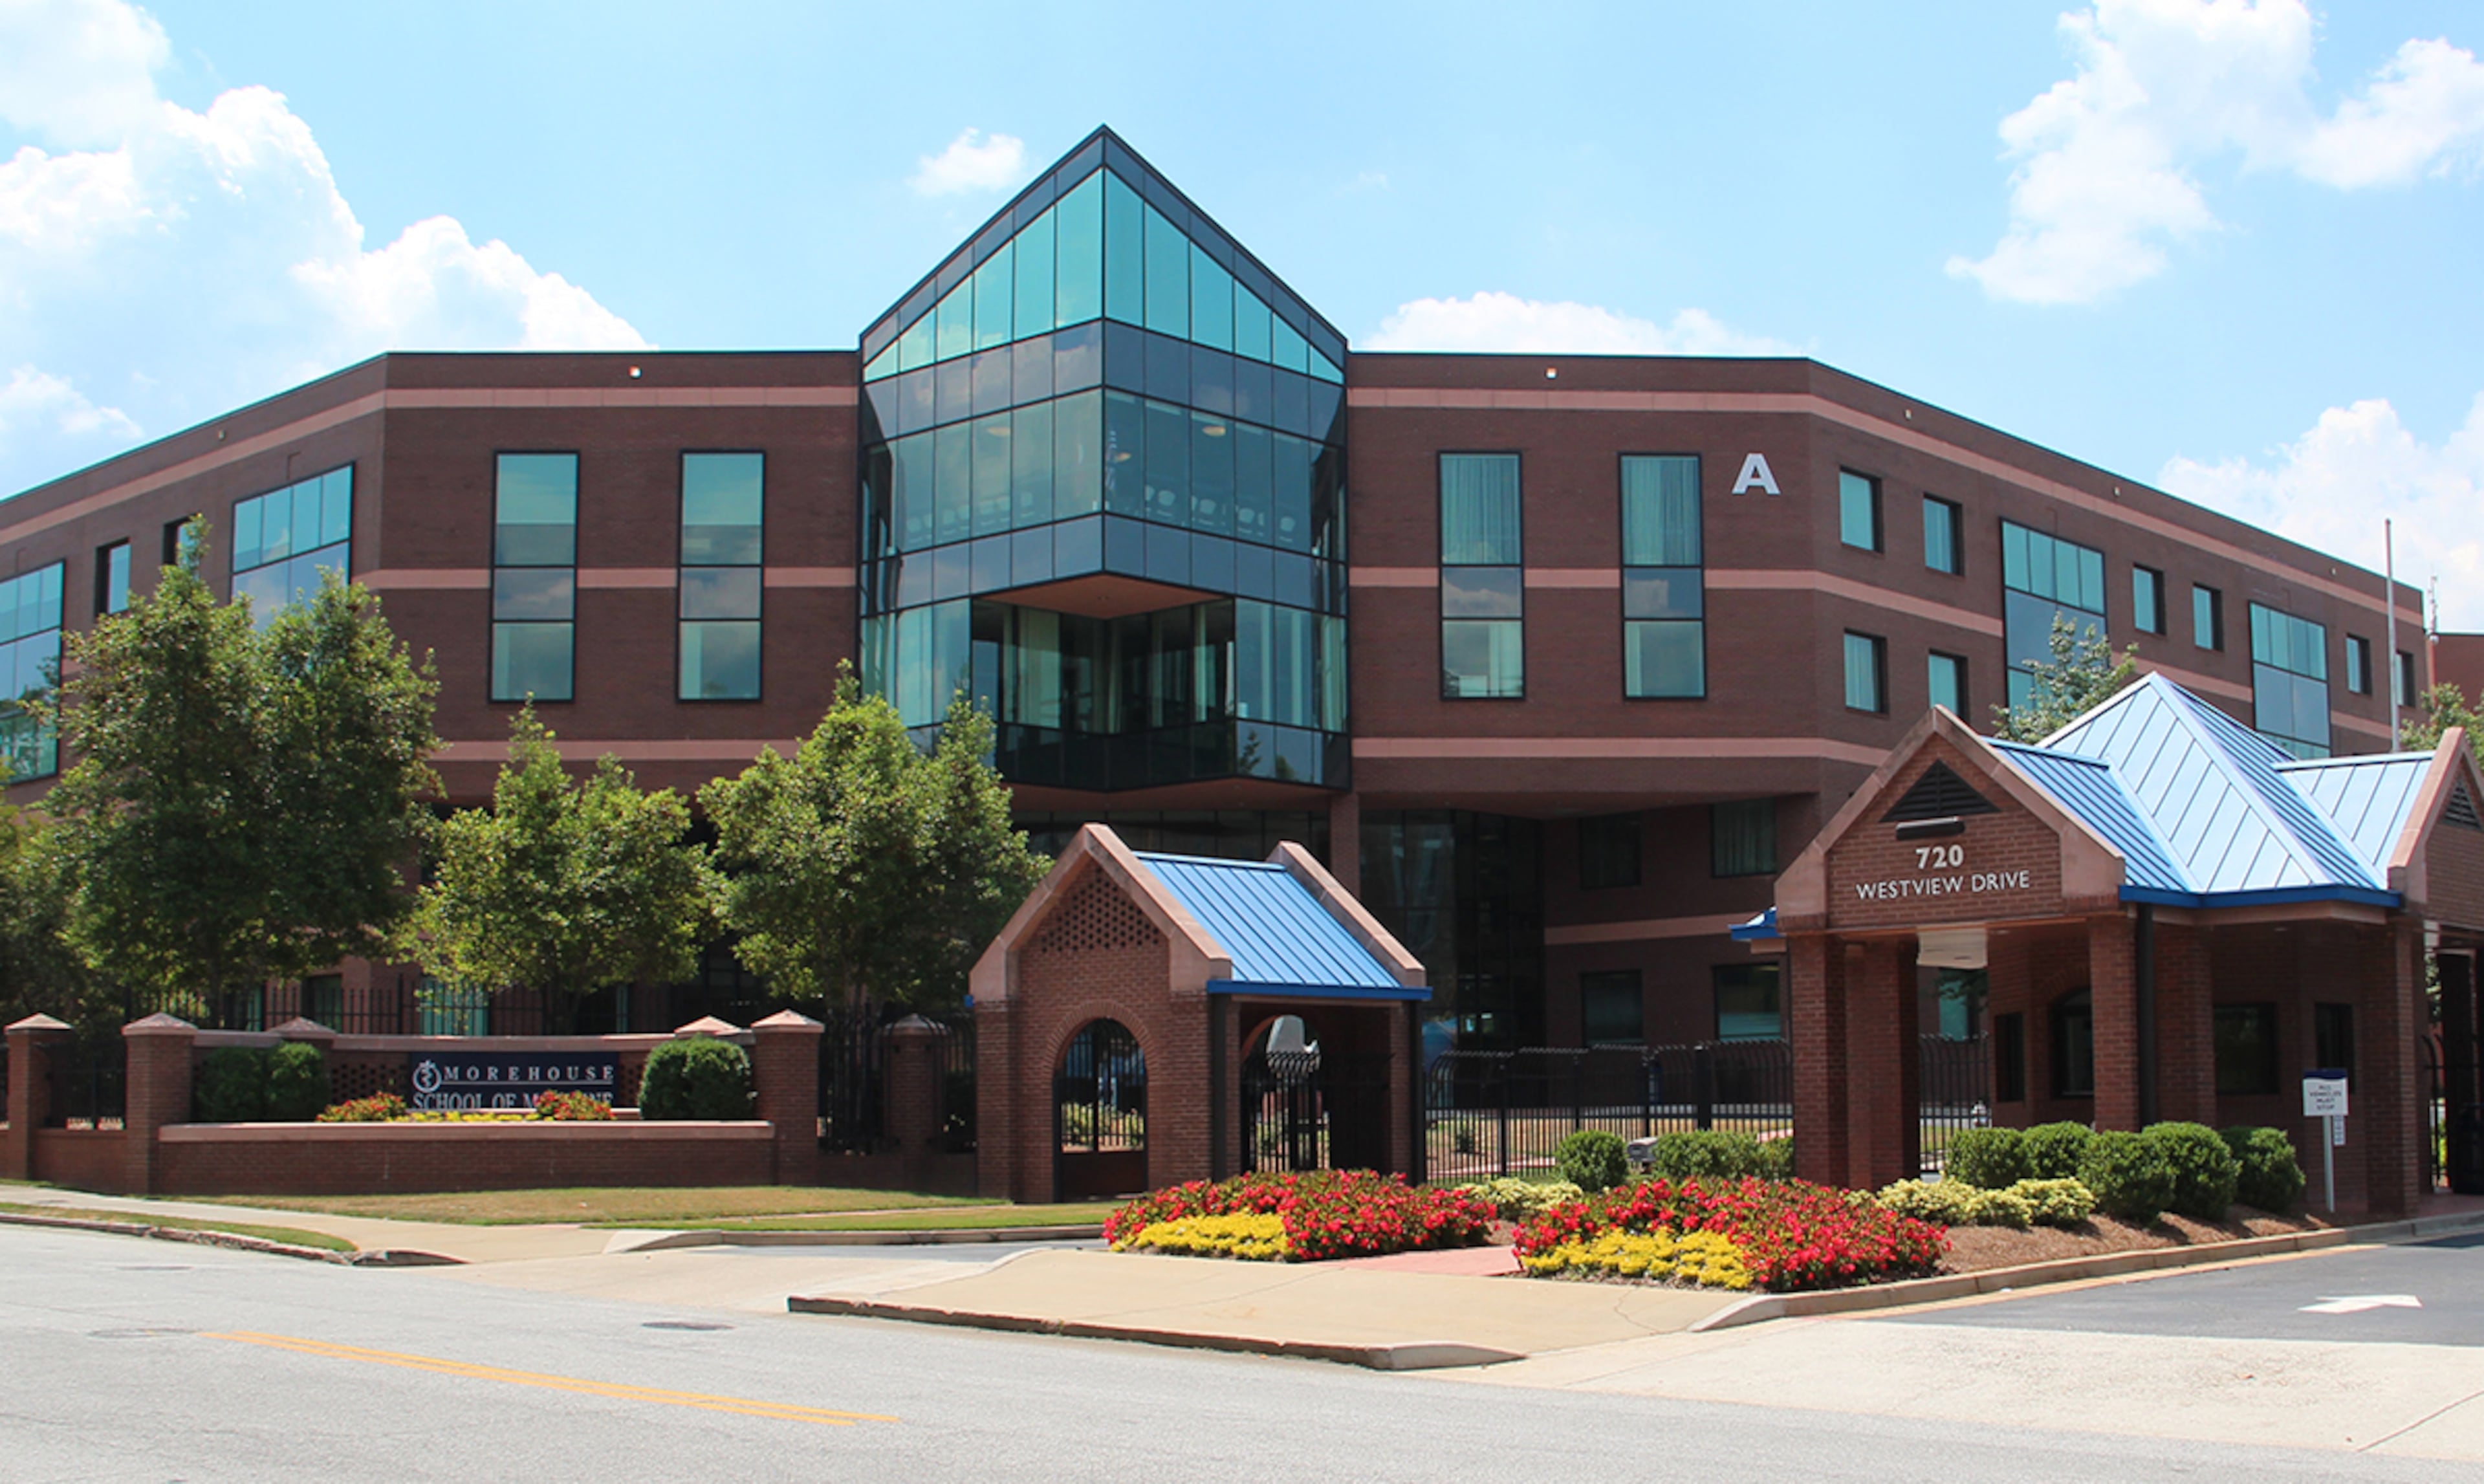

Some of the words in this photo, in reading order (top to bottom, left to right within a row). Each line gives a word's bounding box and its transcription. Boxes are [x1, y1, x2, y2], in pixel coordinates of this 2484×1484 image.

[1732, 452, 1781, 494] A
[1915, 844, 1965, 869] 720
[1855, 875, 1964, 900] WESTVIEW
[1971, 870, 2030, 893] DRIVE
[444, 1066, 614, 1081] MOREHOUSE
[413, 1092, 482, 1109] SCHOOL
[491, 1092, 517, 1108] OF
